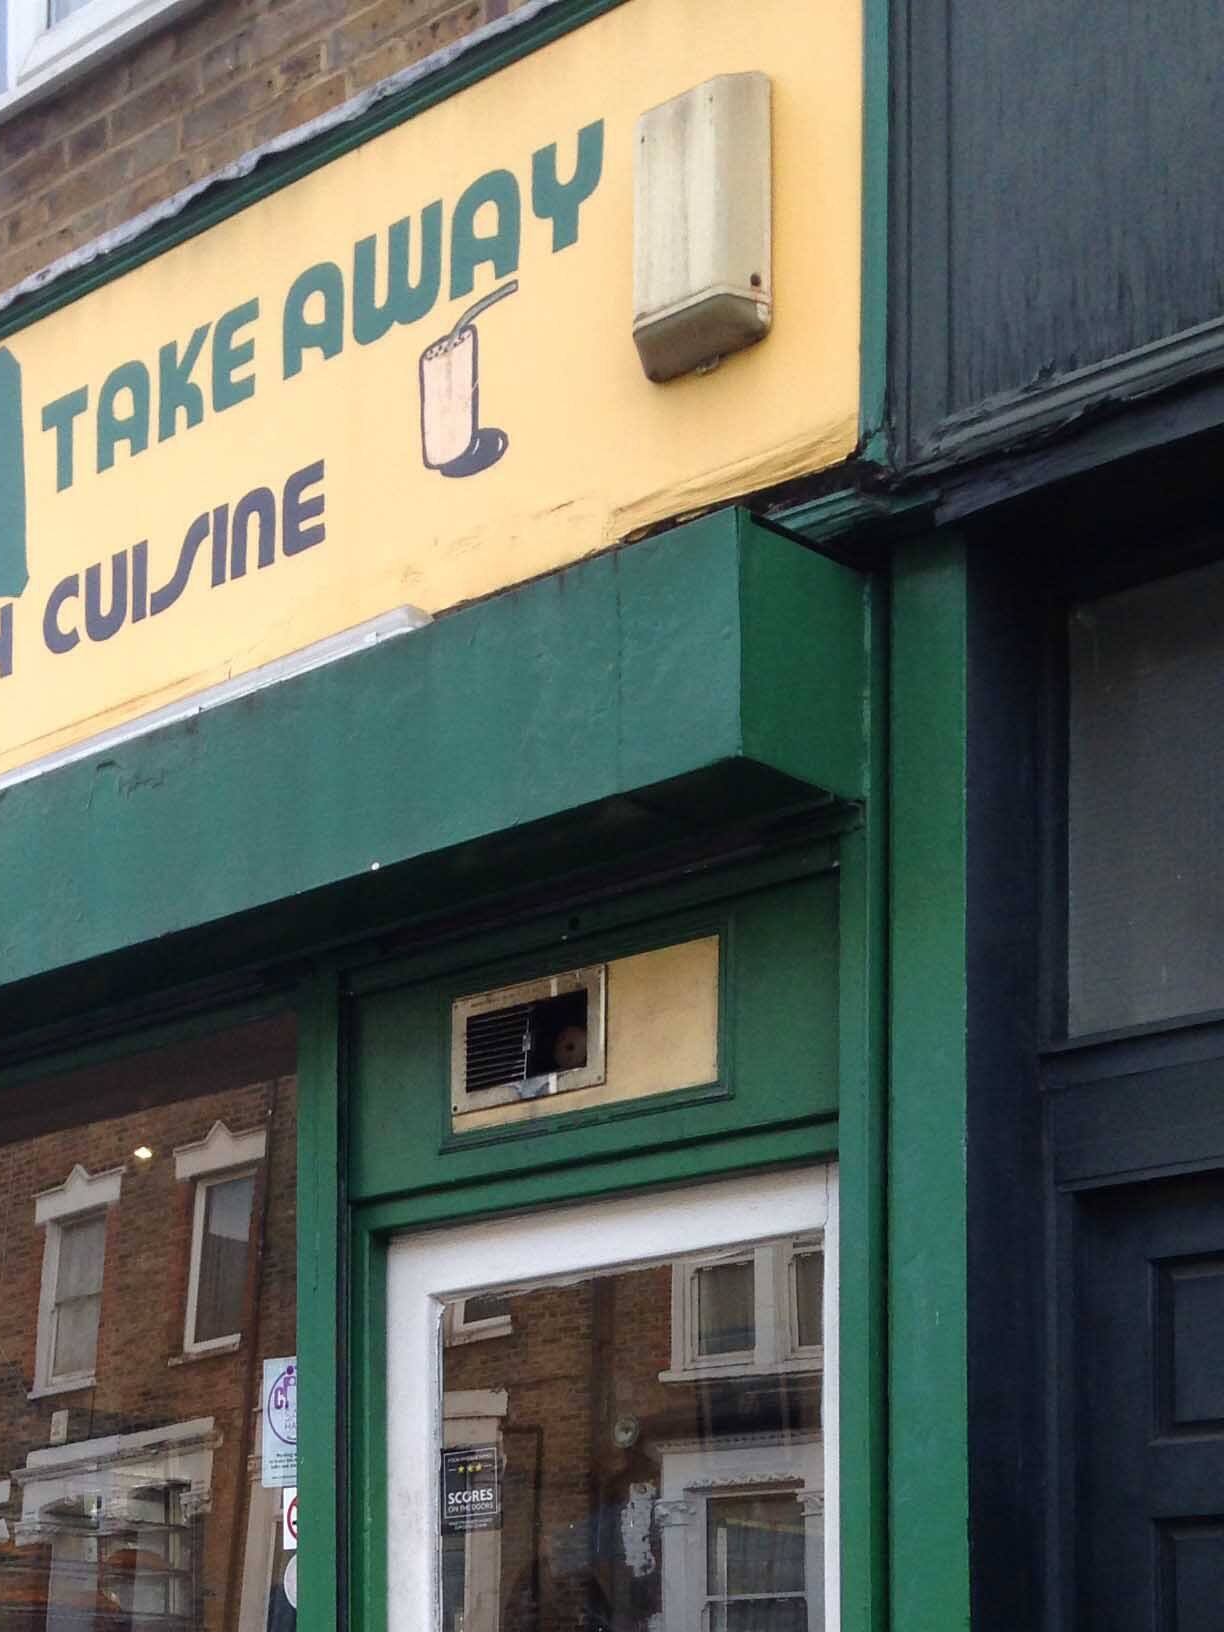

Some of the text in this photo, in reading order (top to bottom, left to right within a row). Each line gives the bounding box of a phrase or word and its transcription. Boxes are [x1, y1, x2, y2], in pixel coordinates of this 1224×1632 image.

[41, 297, 260, 493] TAKE
[282, 118, 605, 381] AWAY
[41, 459, 327, 655] CUISINE
[448, 1488, 494, 1505] SCORES
